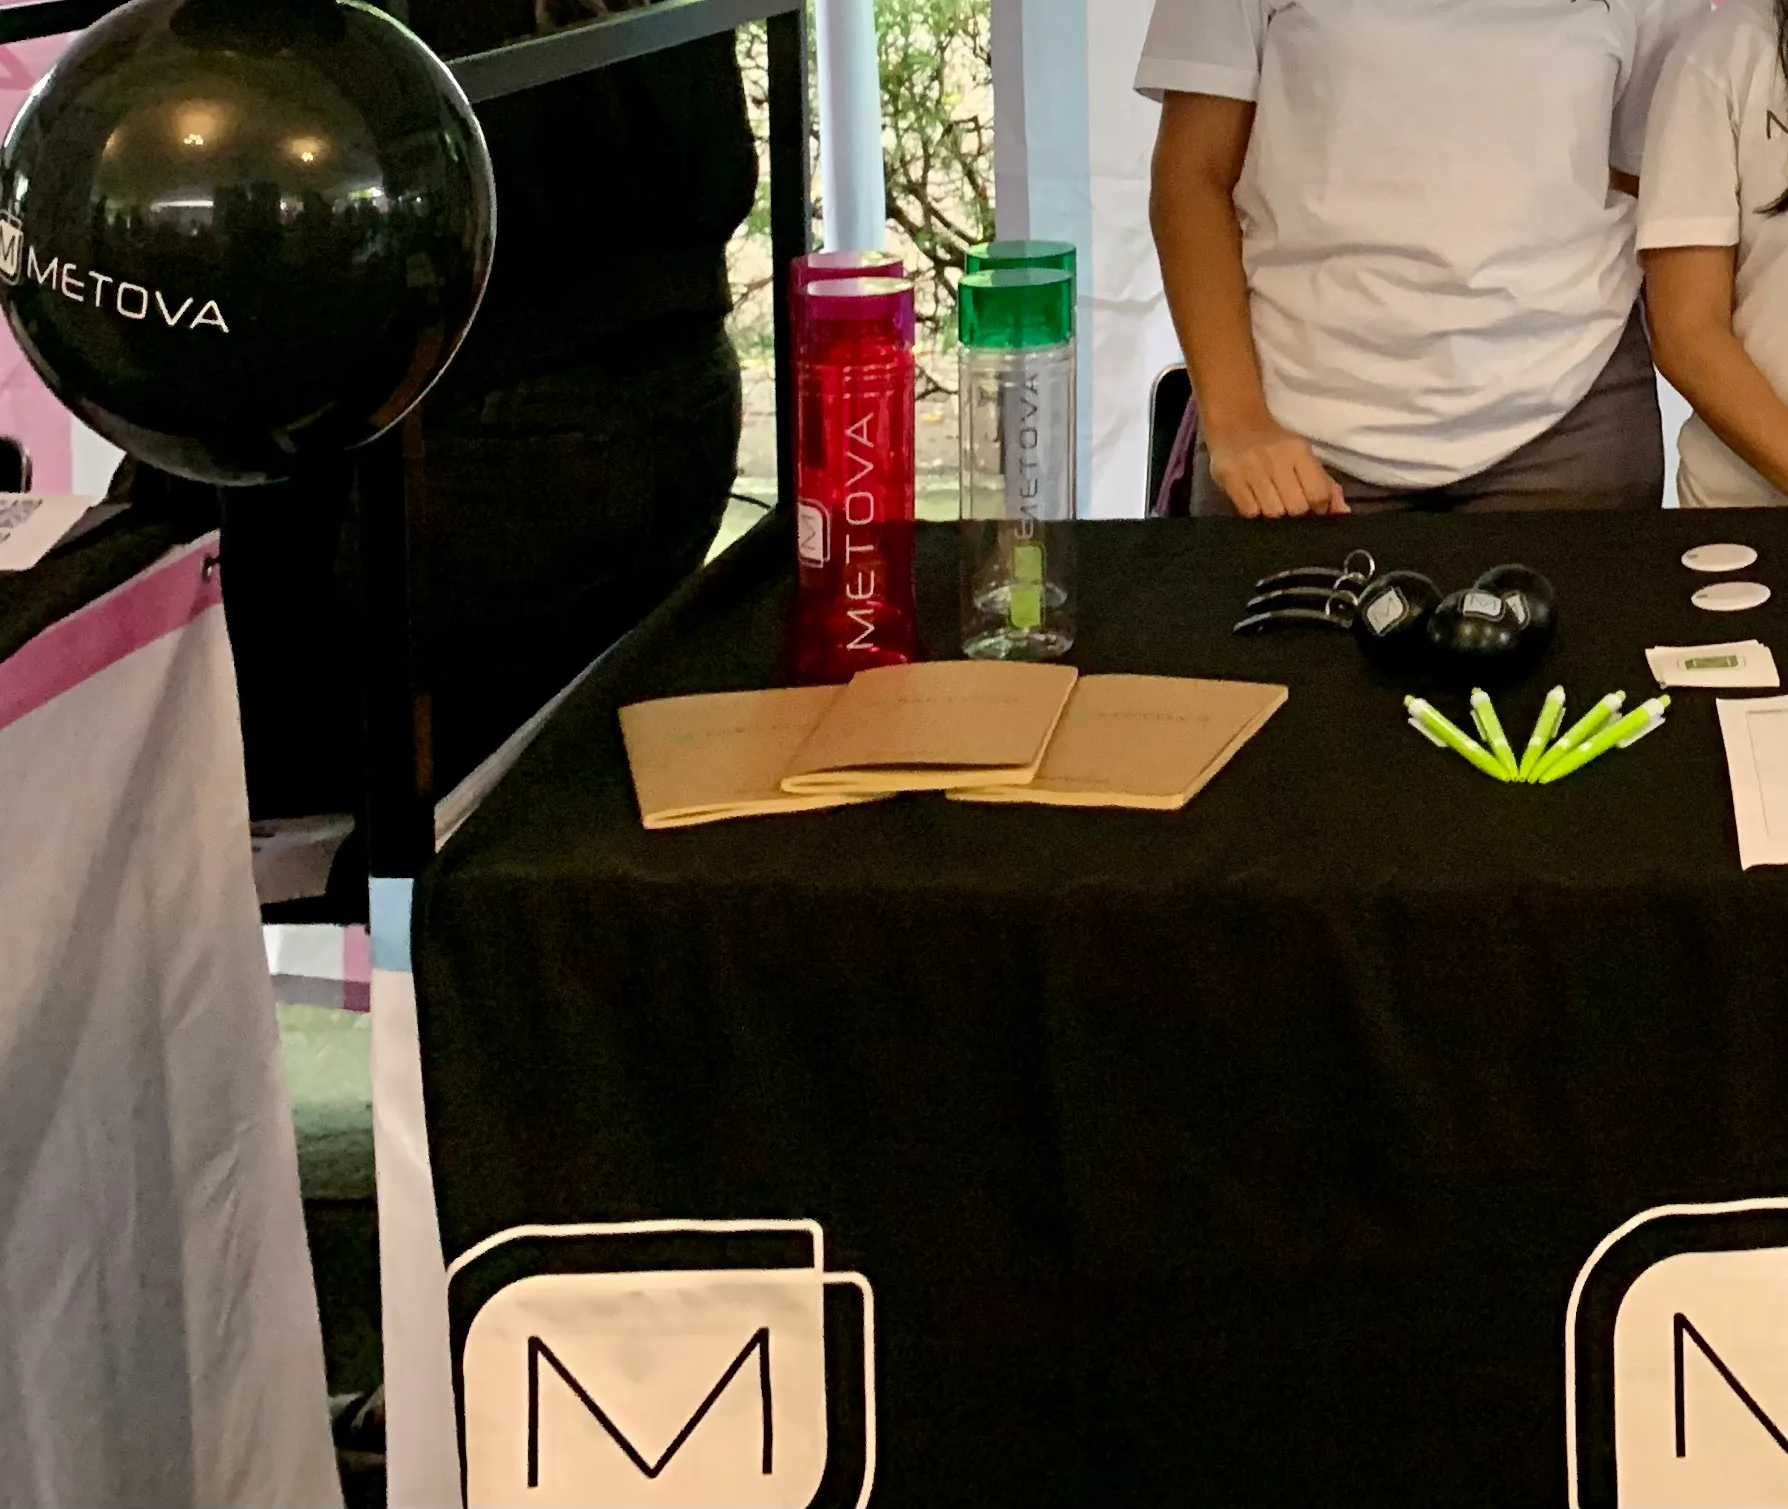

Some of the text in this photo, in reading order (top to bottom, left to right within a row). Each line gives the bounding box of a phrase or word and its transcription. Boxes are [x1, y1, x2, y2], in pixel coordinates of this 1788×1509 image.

[27, 245, 231, 334] METOVA
[845, 412, 875, 651] METOVA
[527, 1327, 774, 1488] M
